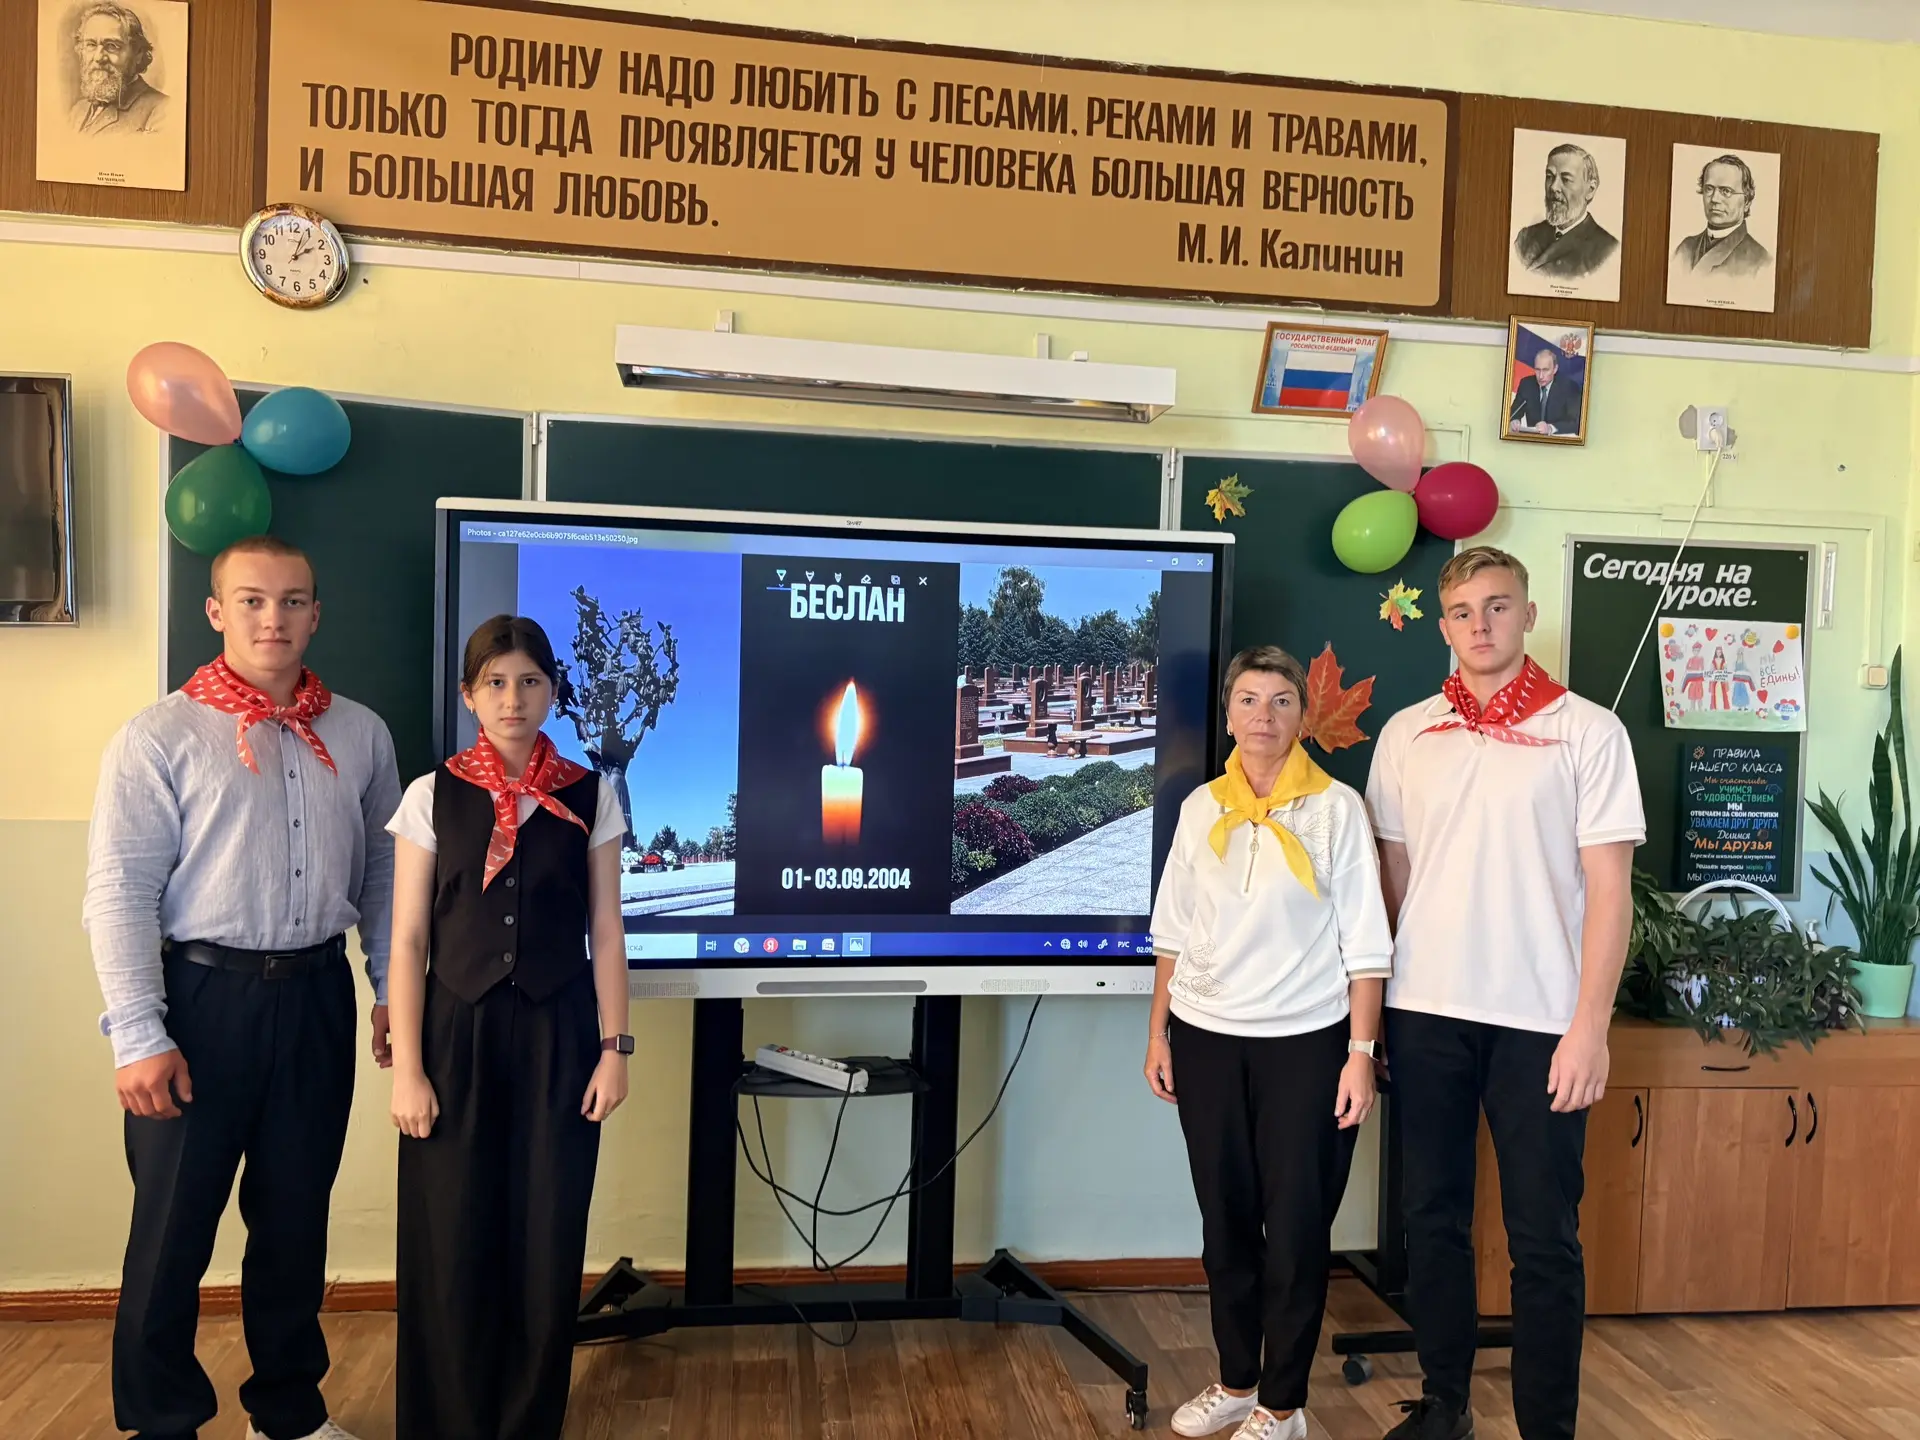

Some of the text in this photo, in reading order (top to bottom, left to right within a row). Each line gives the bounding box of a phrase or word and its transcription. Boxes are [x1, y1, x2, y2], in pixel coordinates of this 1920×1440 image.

[451, 33, 603, 91] РОДИНУ
[619, 51, 715, 110] НАДО
[730, 63, 879, 117] ЛЮБИТЬ
[896, 78, 917, 120] С
[1086, 97, 1216, 147] РЕКАМИ
[1231, 109, 1252, 150] И
[1267, 111, 1428, 168] ТРАВАМИ,
[302, 82, 1415, 221] ТОЛЬКО ТОГДА ПРОЯВЛЯЕТСЯ У ЧЕЛОВЕКА БОЛЬШАЯ ВЕРНОСТЬ
[300, 146, 720, 228] И БОЛЬШАЯ ЛЮБОВЬ.
[273, 224, 284, 236] 11
[287, 222, 301, 234] 12
[305, 227, 311, 238] 1
[263, 234, 275, 246] 10
[318, 239, 325, 251] 2
[259, 249, 266, 260] 9
[1260, 227, 1404, 278] Калинин
[324, 255, 331, 266] 3
[266, 264, 273, 276] 8
[319, 269, 326, 280] 4
[279, 276, 287, 287] 7
[294, 281, 301, 292] 6
[309, 279, 316, 289] 5
[1275, 332, 1377, 347] ГОСУДАРСТВЕННЫЙ ФЛАГ
[1325, 345, 1357, 353] ФЕДЕРАЦИИ
[467, 528, 492, 537] Photos
[1583, 552, 1753, 586] Сегодня на
[790, 583, 905, 623] БЕСЛАН
[1660, 586, 1758, 611] уроке.
[1760, 664, 1777, 677] ВСЕ
[1760, 666, 1800, 689] ЕДИНЫ!
[1713, 748, 1761, 759] ПРАВИЛА
[1689, 762, 1784, 774] НАШЕГО КЛАССА
[1719, 785, 1753, 794] УЧИМСЯ
[1703, 793, 1774, 803] УДОВОЛЬСТВИЕМ
[1727, 802, 1743, 811] МЫ
[1690, 817, 1778, 830] УВАЖАЕМ ДРУГ ДРУГА
[814, 867, 911, 890] 03.09.2004
[1687, 872, 1702, 882] МЫ
